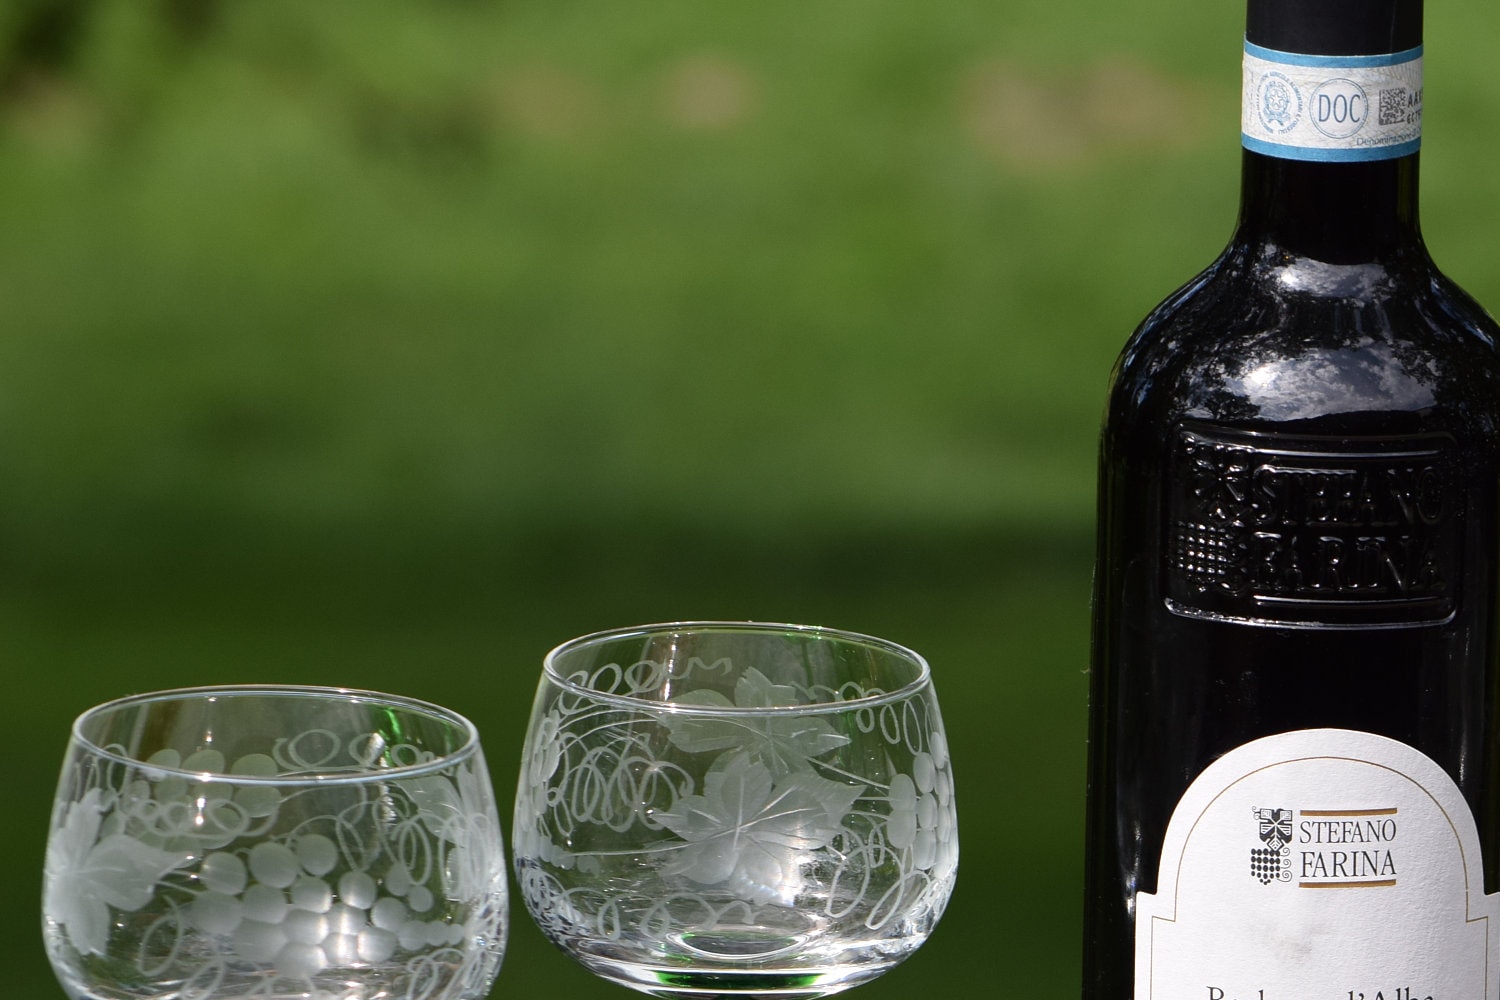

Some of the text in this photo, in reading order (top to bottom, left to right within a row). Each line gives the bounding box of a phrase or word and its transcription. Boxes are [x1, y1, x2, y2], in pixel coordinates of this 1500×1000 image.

[1318, 94, 1361, 123] DOC
[1299, 818, 1397, 844] STEFANO
[1299, 849, 1398, 878] FARINA
